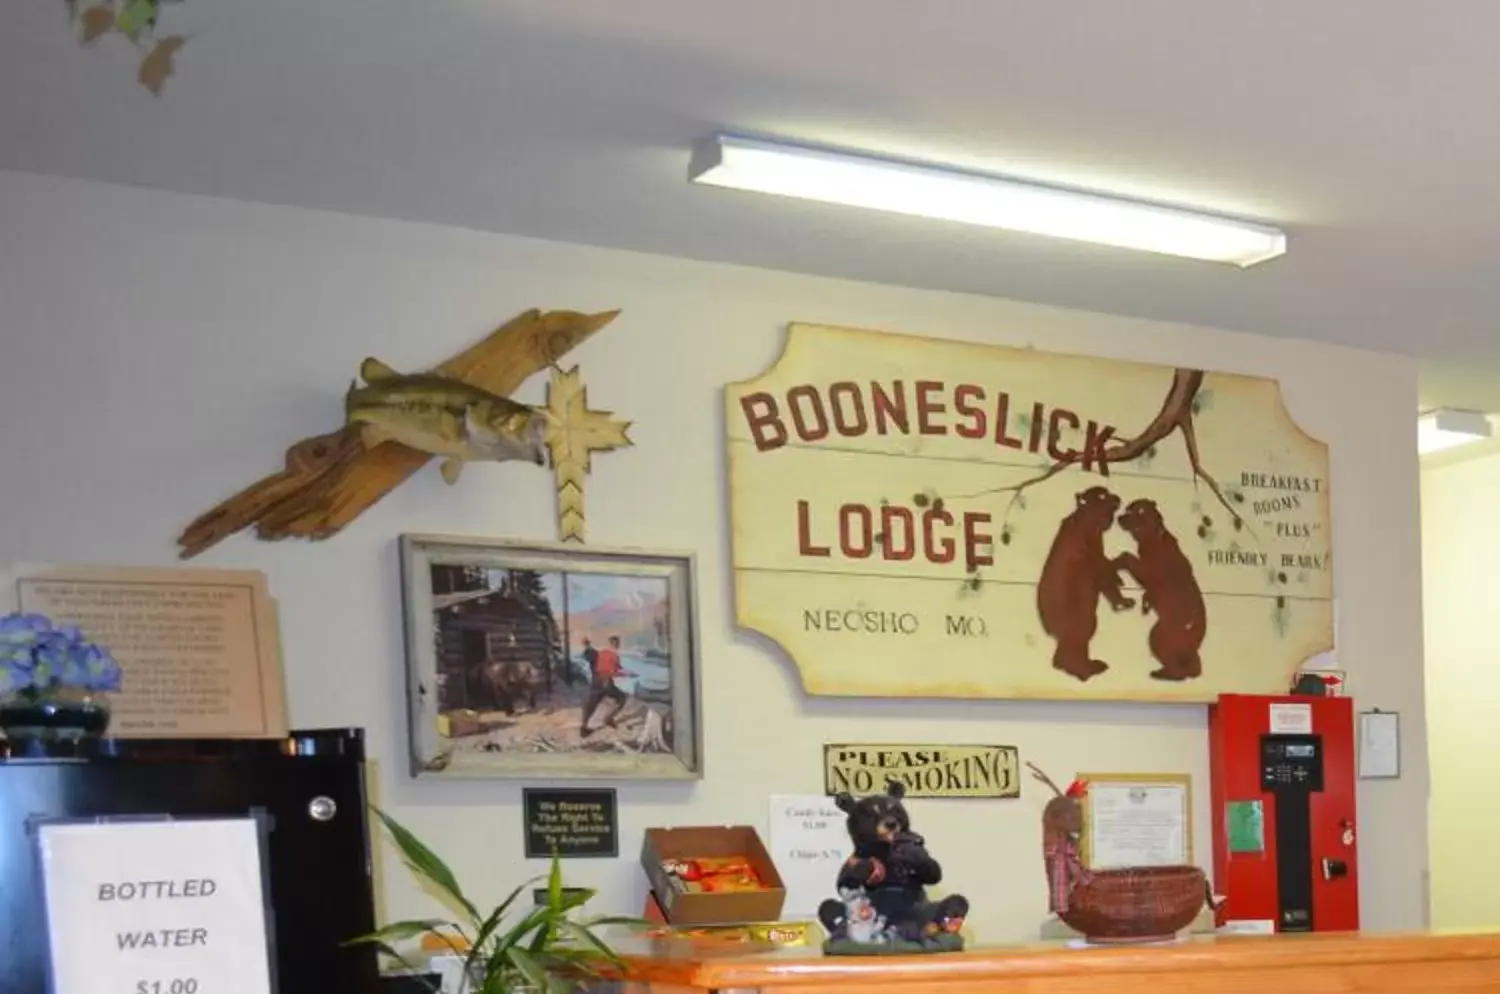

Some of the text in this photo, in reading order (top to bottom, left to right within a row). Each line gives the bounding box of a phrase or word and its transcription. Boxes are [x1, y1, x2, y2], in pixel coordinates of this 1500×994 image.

[740, 380, 1117, 477] BOONESLICK
[1241, 471, 1322, 493] BREAKFAST
[1253, 496, 1300, 516] ROOMS
[797, 500, 994, 567] LODGE
[1208, 550, 1267, 566] FRIENDLY
[803, 609, 919, 636] NEOSHO
[832, 748, 1010, 792] NO SMOKING
[839, 750, 948, 768] PLEASE
[538, 813, 604, 824] The Right To
[571, 823, 610, 833] Service
[561, 834, 600, 846] Anyone
[98, 877, 217, 902] BOTTLED
[116, 927, 208, 951] WATER
